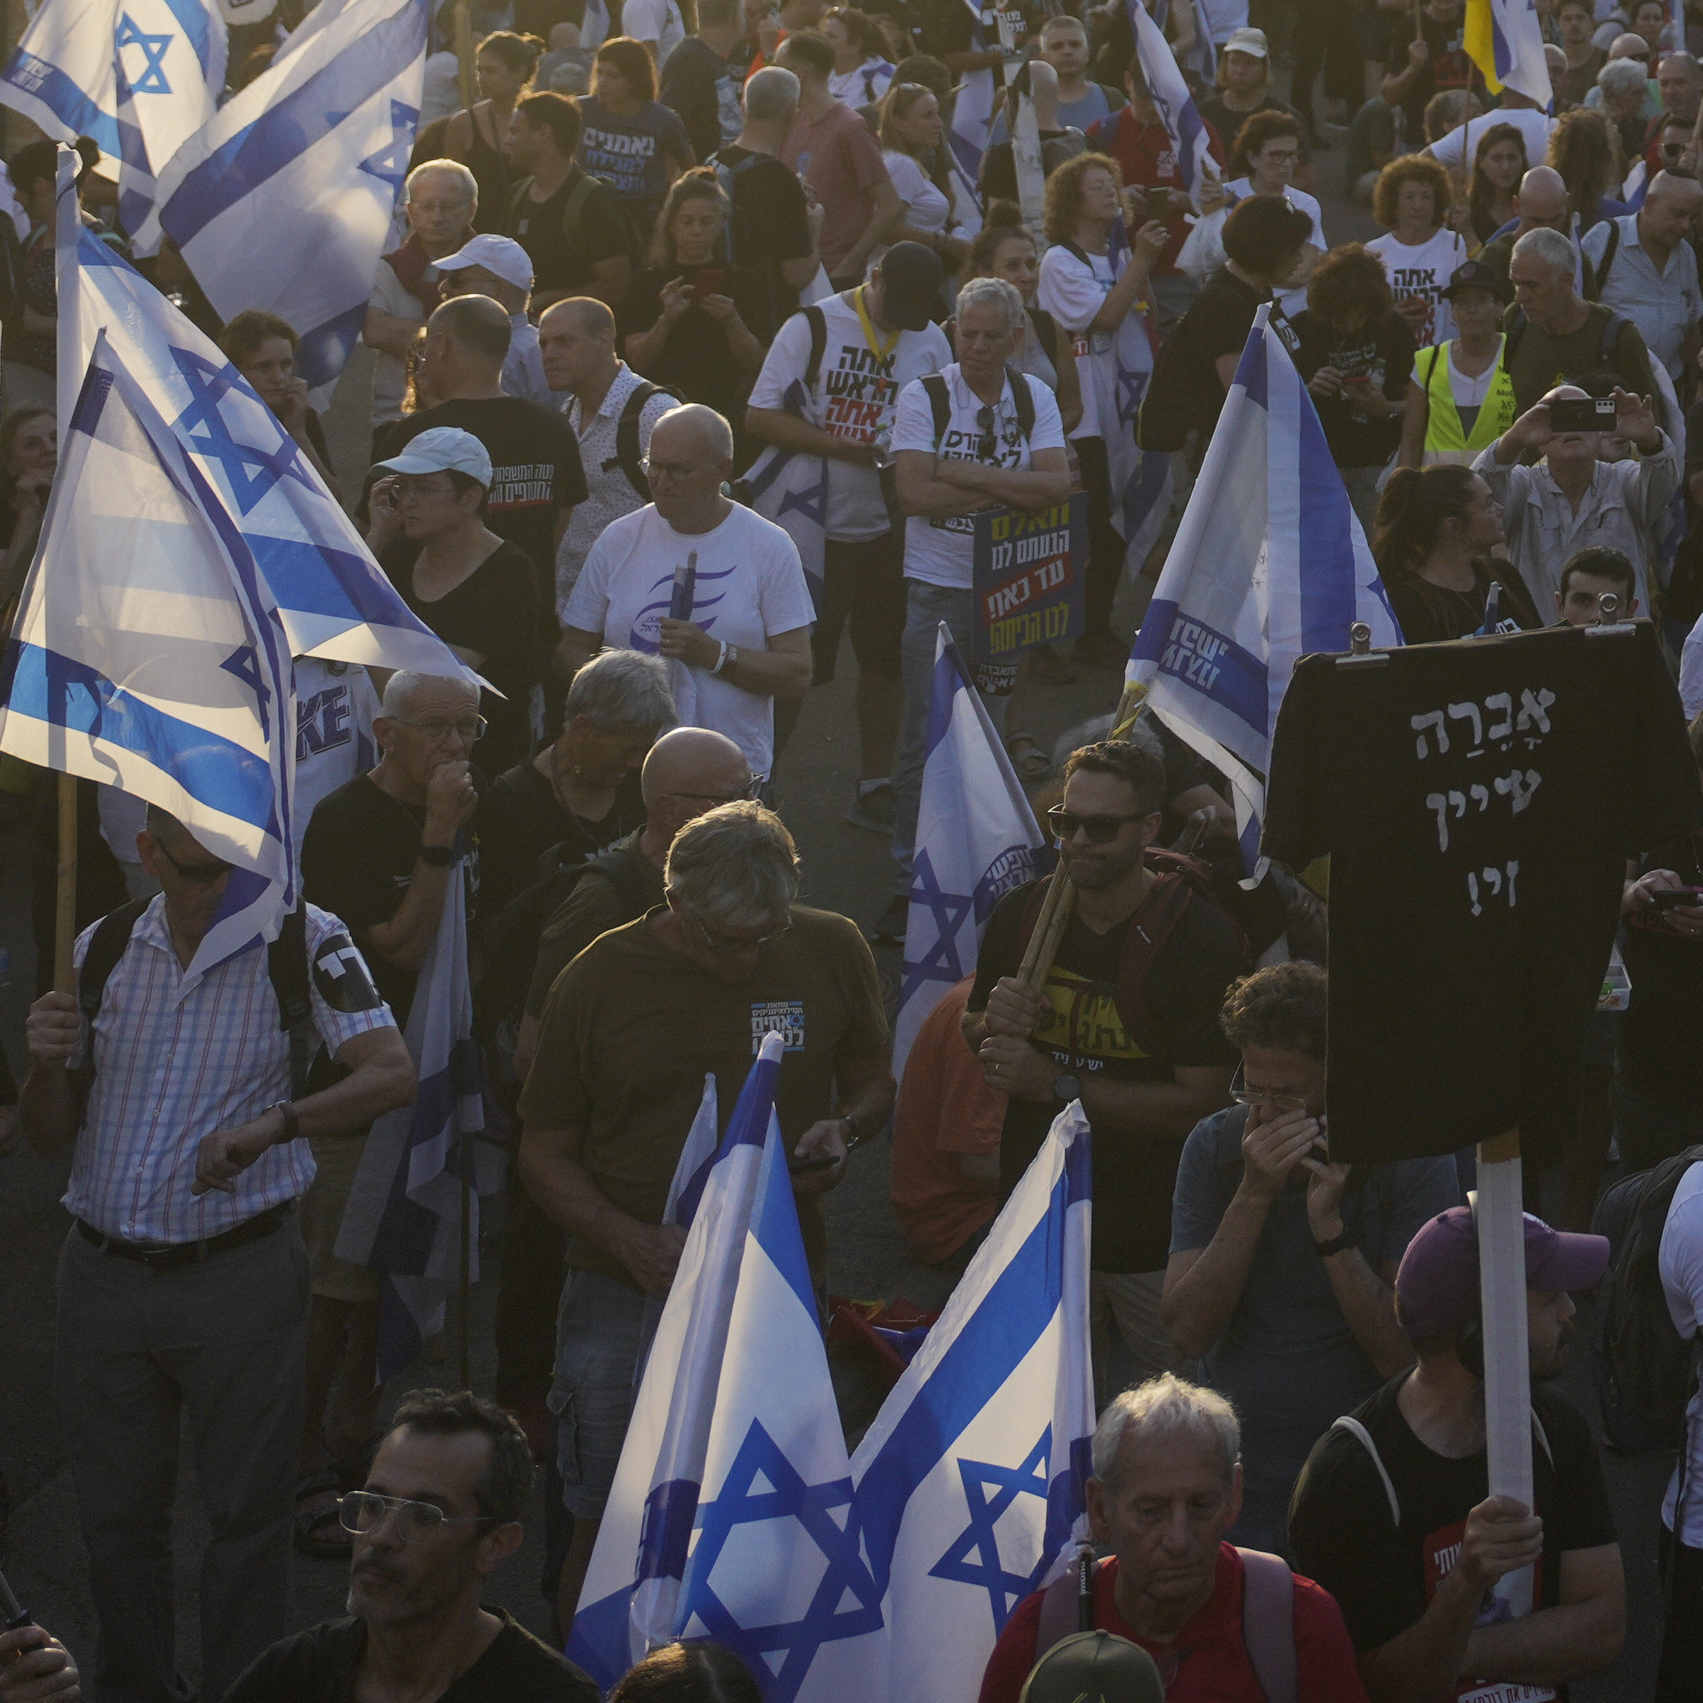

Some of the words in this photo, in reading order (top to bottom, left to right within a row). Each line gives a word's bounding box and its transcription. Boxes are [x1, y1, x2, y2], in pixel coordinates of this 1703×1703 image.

[584, 127, 656, 157] נאמנים
[1394, 268, 1436, 287] אתה
[838, 345, 897, 378] אתה
[826, 370, 900, 405] הראש
[990, 541, 1014, 571] לנו
[1033, 558, 1066, 591] עד
[987, 576, 1032, 620] כאן!
[990, 610, 1042, 655] הביתה!
[1046, 600, 1070, 640] לכו
[1088, 1057, 1105, 1072] יש
